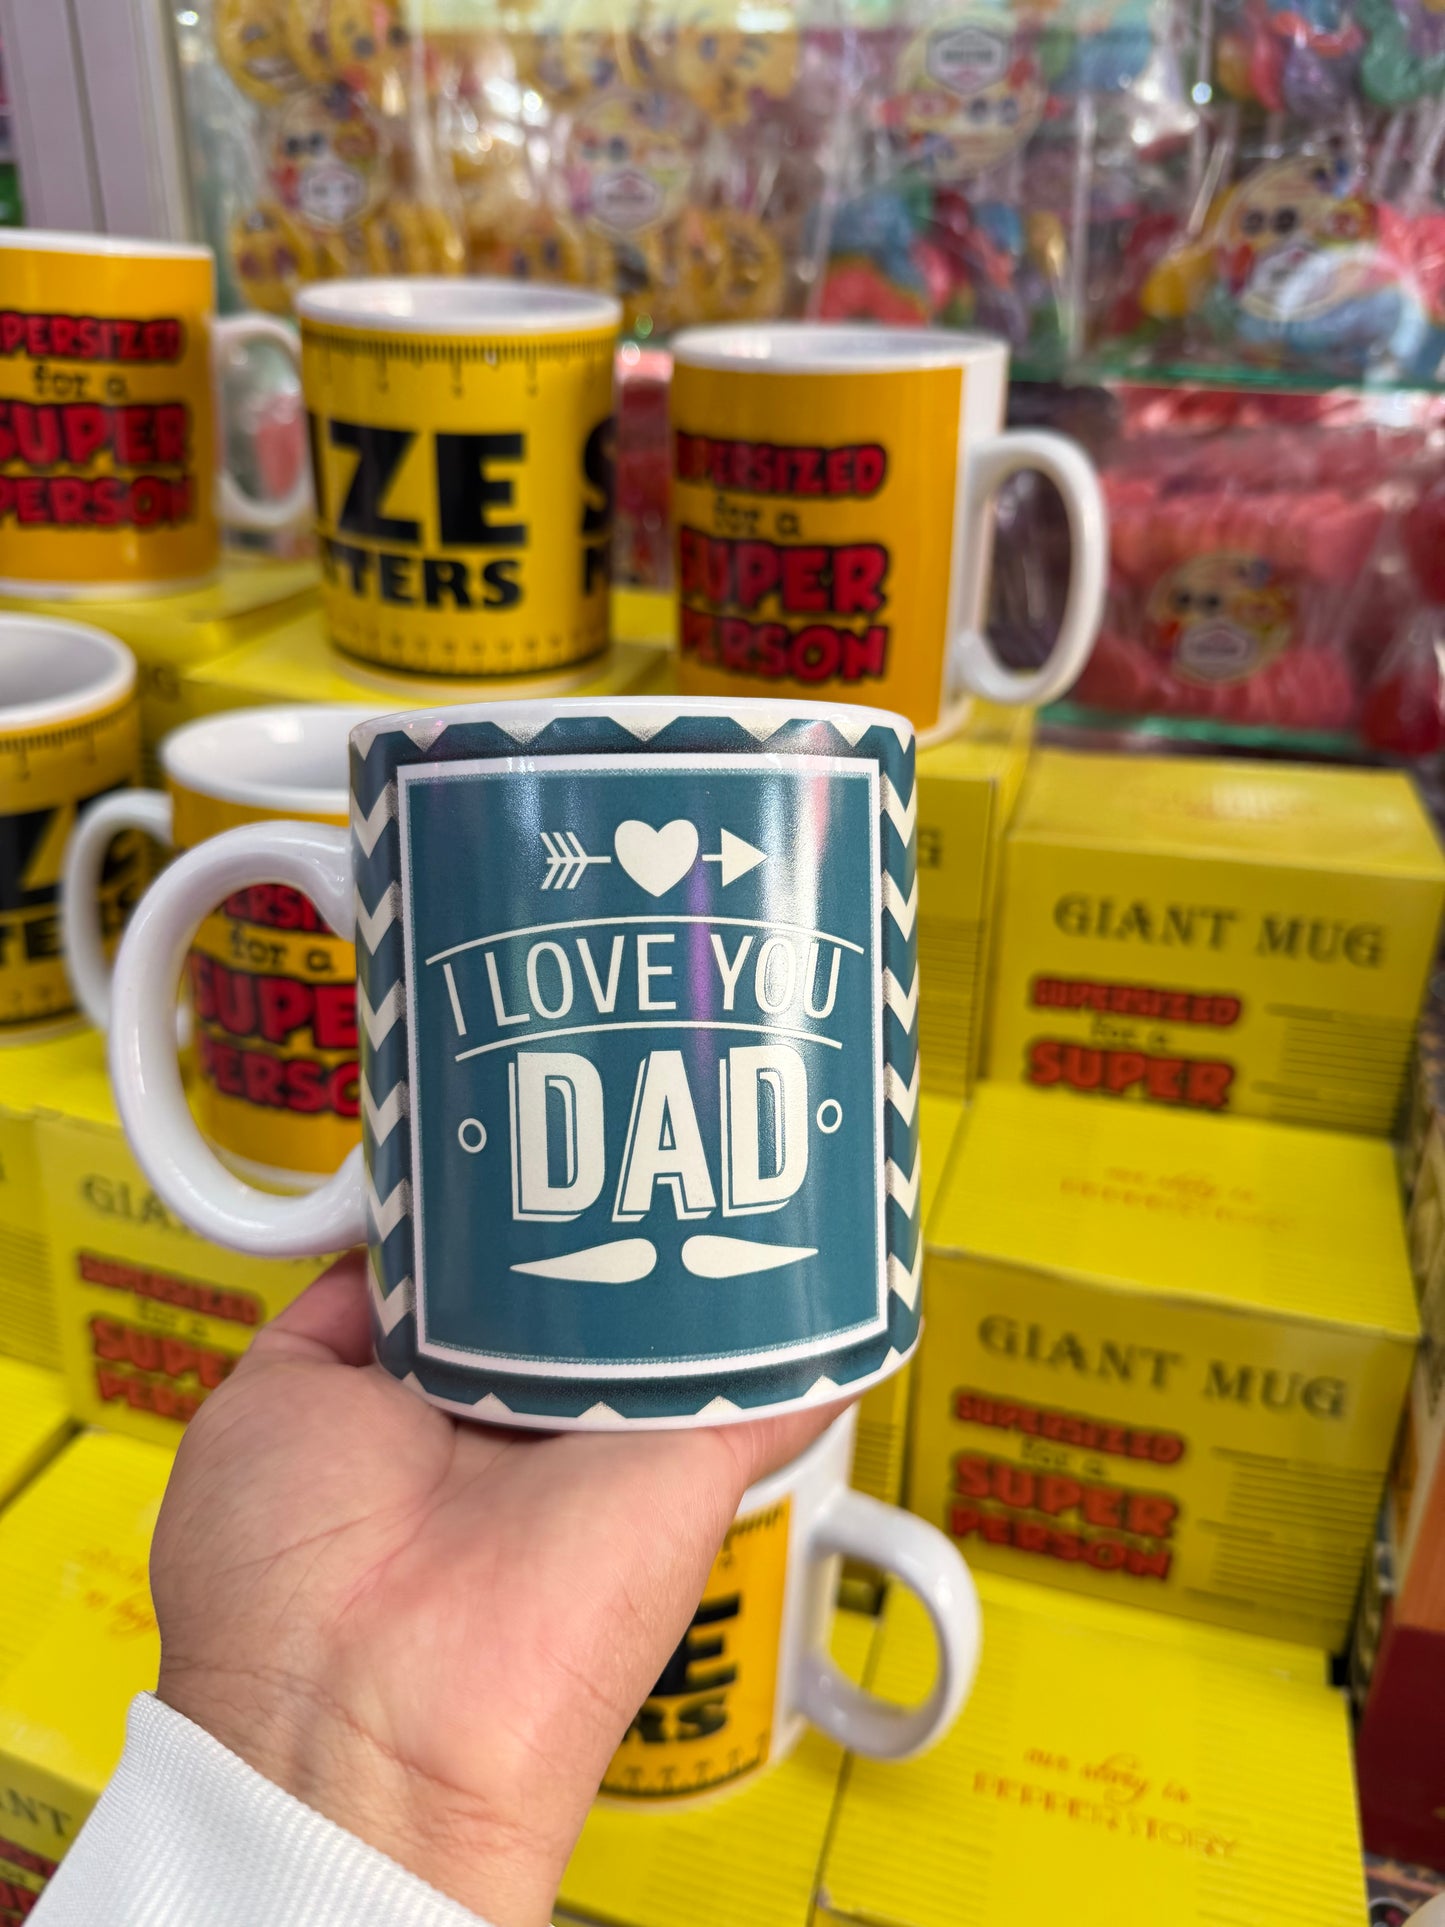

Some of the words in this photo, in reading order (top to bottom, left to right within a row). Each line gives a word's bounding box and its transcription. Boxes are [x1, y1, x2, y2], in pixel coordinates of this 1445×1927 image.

[1053, 892, 1242, 952] GIANT
[1254, 912, 1386, 970] MUG
[444, 963, 467, 1036] I
[484, 933, 678, 1026] LOVE
[711, 933, 842, 1020] YOU
[1026, 1040, 1236, 1110] SUPER
[508, 1044, 812, 1223] DAD
[978, 1313, 1184, 1390] GIANT
[1204, 1360, 1348, 1420] MUG
[952, 1450, 1182, 1540] SUPER
[948, 1500, 1174, 1582] PERSON
